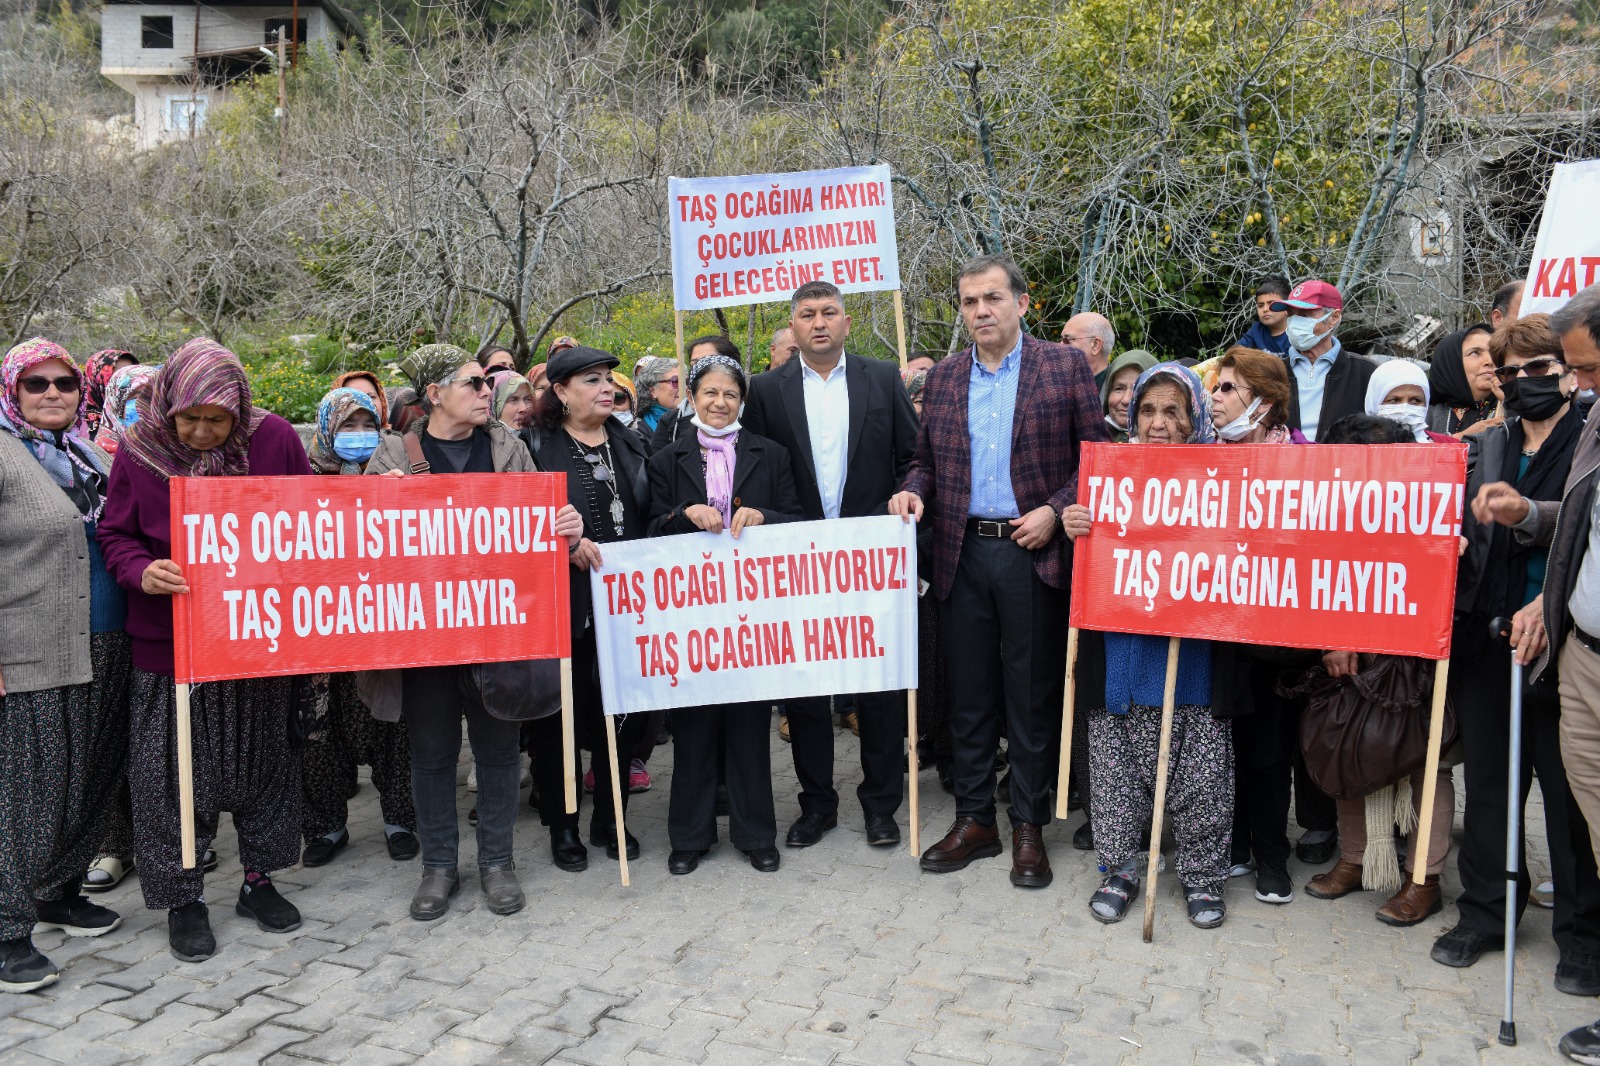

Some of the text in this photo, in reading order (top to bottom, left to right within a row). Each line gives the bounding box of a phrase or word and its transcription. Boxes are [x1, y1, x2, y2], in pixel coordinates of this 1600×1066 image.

[677, 181, 886, 228] TAŞ OCAĞINA HAYIR!
[694, 256, 884, 300] GELECEĞİNE EVET.
[697, 220, 877, 268] ÇOCUKLARIMIZIN
[183, 496, 557, 578] TAŞ OCAĞI İSTEMİYORUZ!
[1088, 467, 1464, 537] TAŞ OCAĞI İSTEMİYORUZ!
[223, 572, 527, 653] TAŞ OCAĞINA HAYIR.
[603, 542, 907, 625] TAŞ OCAĞI İSTEMİYORUZ!
[1113, 542, 1417, 616] TAŞ OCAĞINA HAYIR.
[635, 614, 885, 687] TAŞ OCAĞINA HAYIR.
